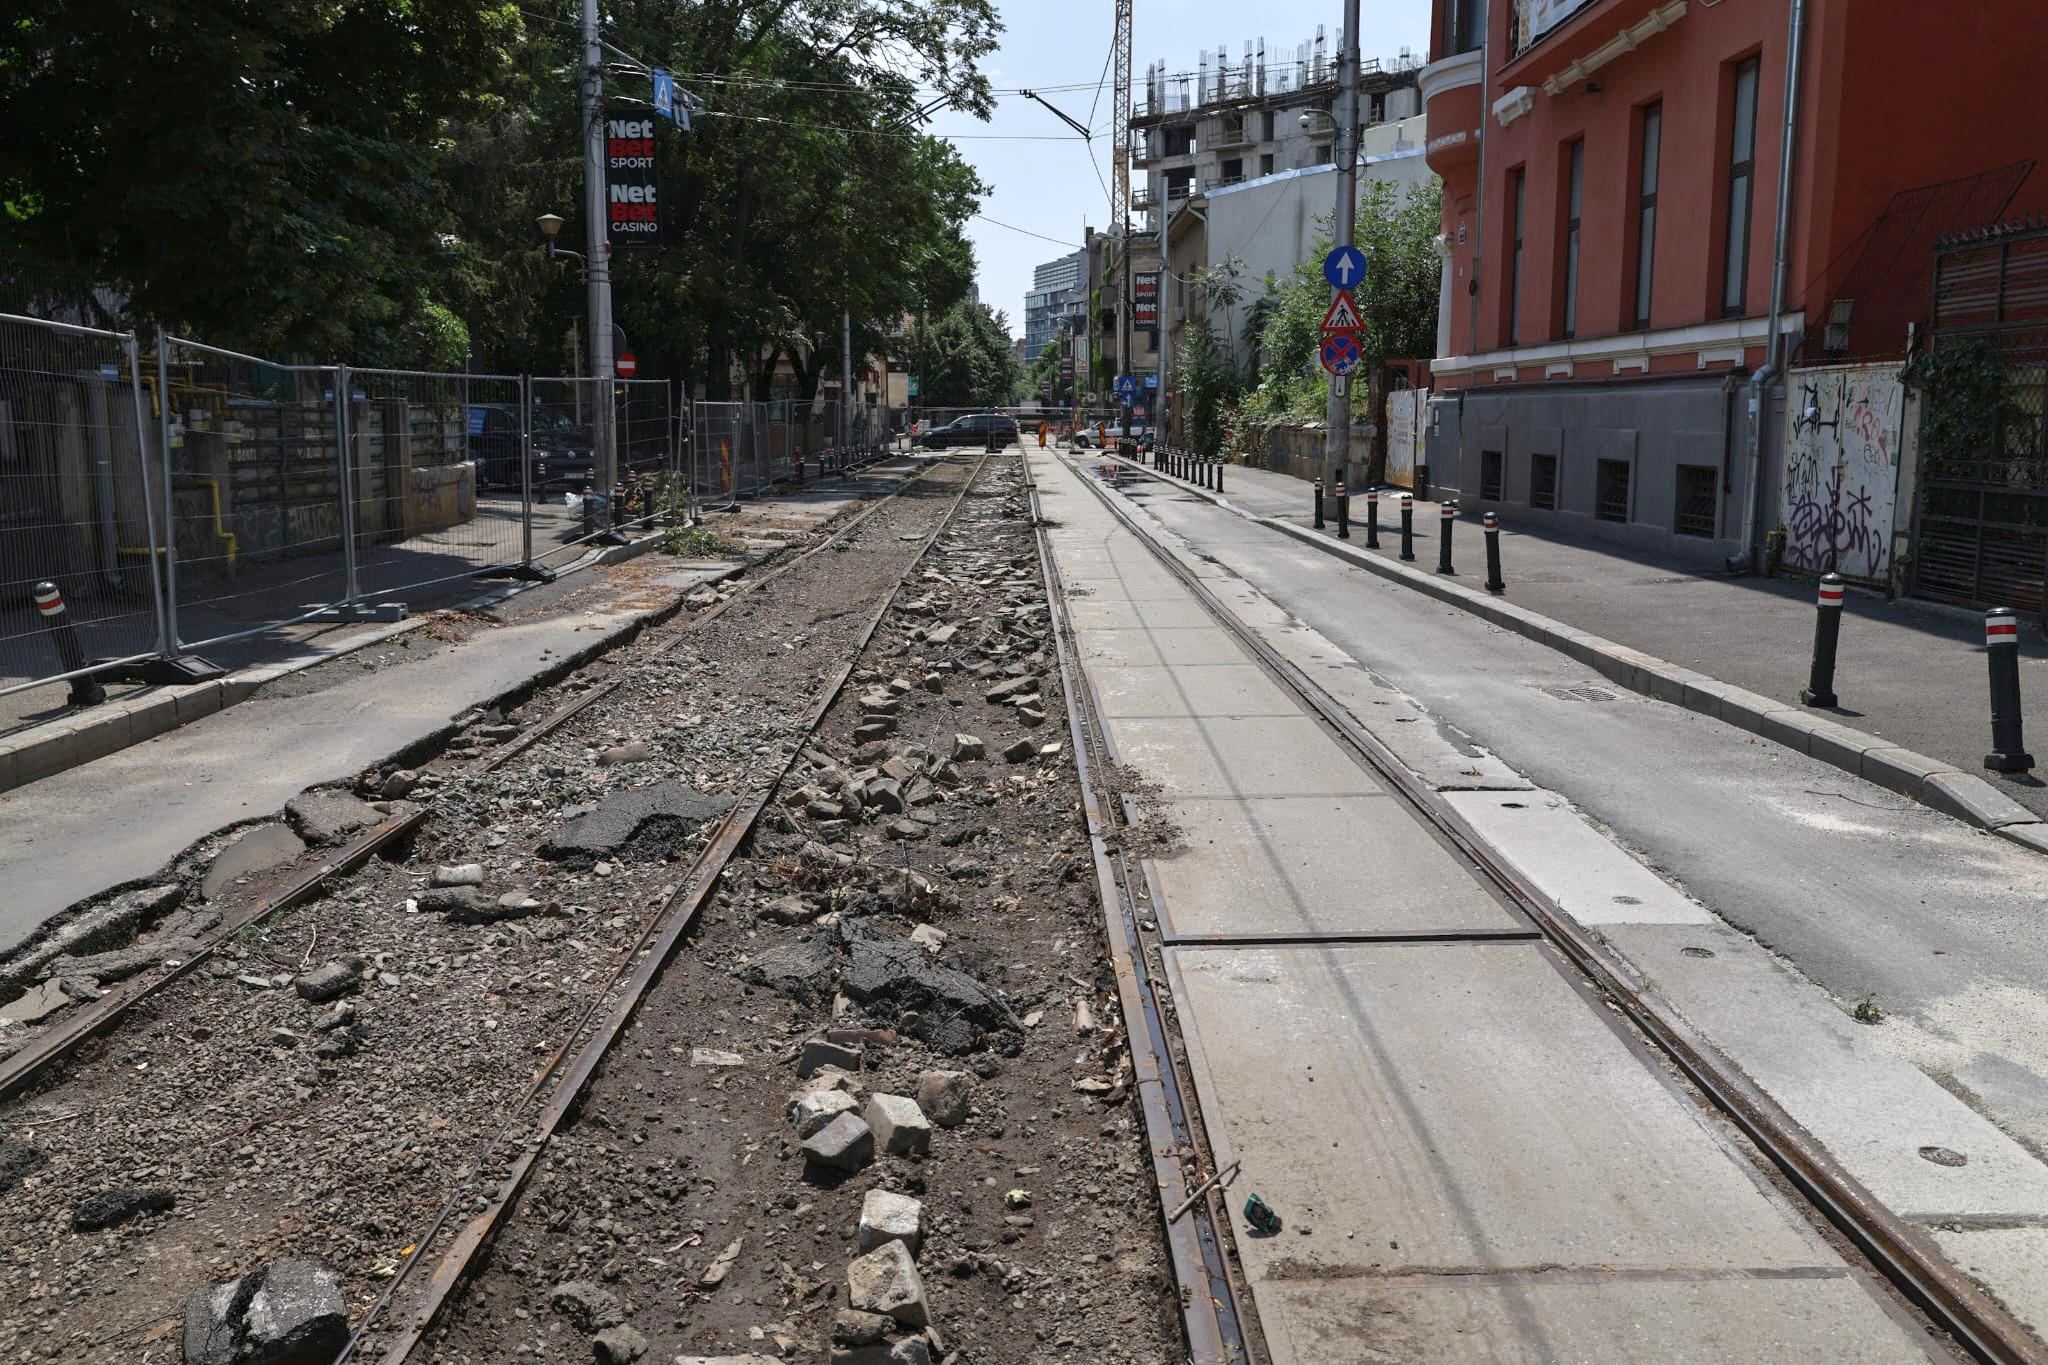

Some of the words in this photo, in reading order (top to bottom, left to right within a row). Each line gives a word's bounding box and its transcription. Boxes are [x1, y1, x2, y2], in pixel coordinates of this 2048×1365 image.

[609, 119, 653, 139] Net
[609, 139, 654, 157] Bet
[610, 157, 655, 169] SPORT
[610, 184, 656, 203] Net
[611, 203, 657, 222] Bet
[612, 222, 658, 232] CASINO
[1136, 276, 1157, 285] Net
[1136, 303, 1157, 312] Net
